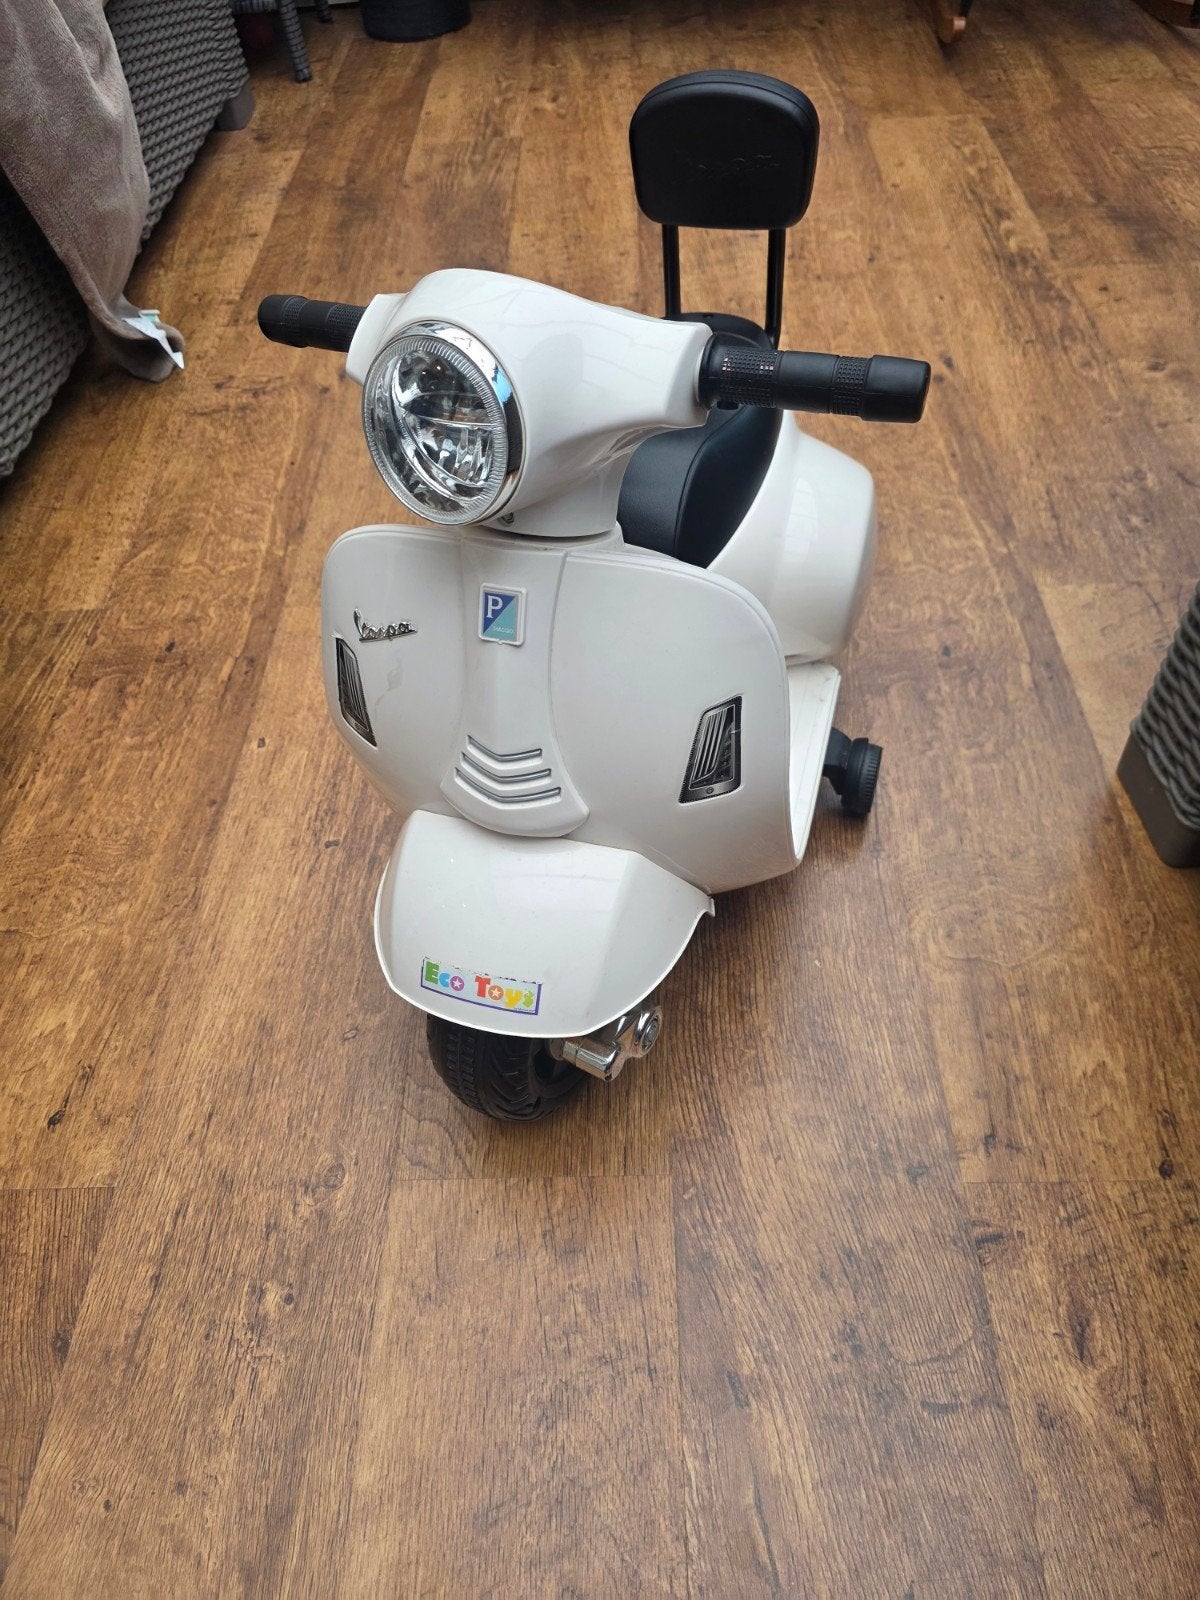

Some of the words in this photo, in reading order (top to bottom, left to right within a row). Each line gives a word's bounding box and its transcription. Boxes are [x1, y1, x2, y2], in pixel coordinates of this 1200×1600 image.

[486, 595, 503, 619] P
[353, 607, 418, 642] Vespa
[474, 975, 535, 1009] Toys
